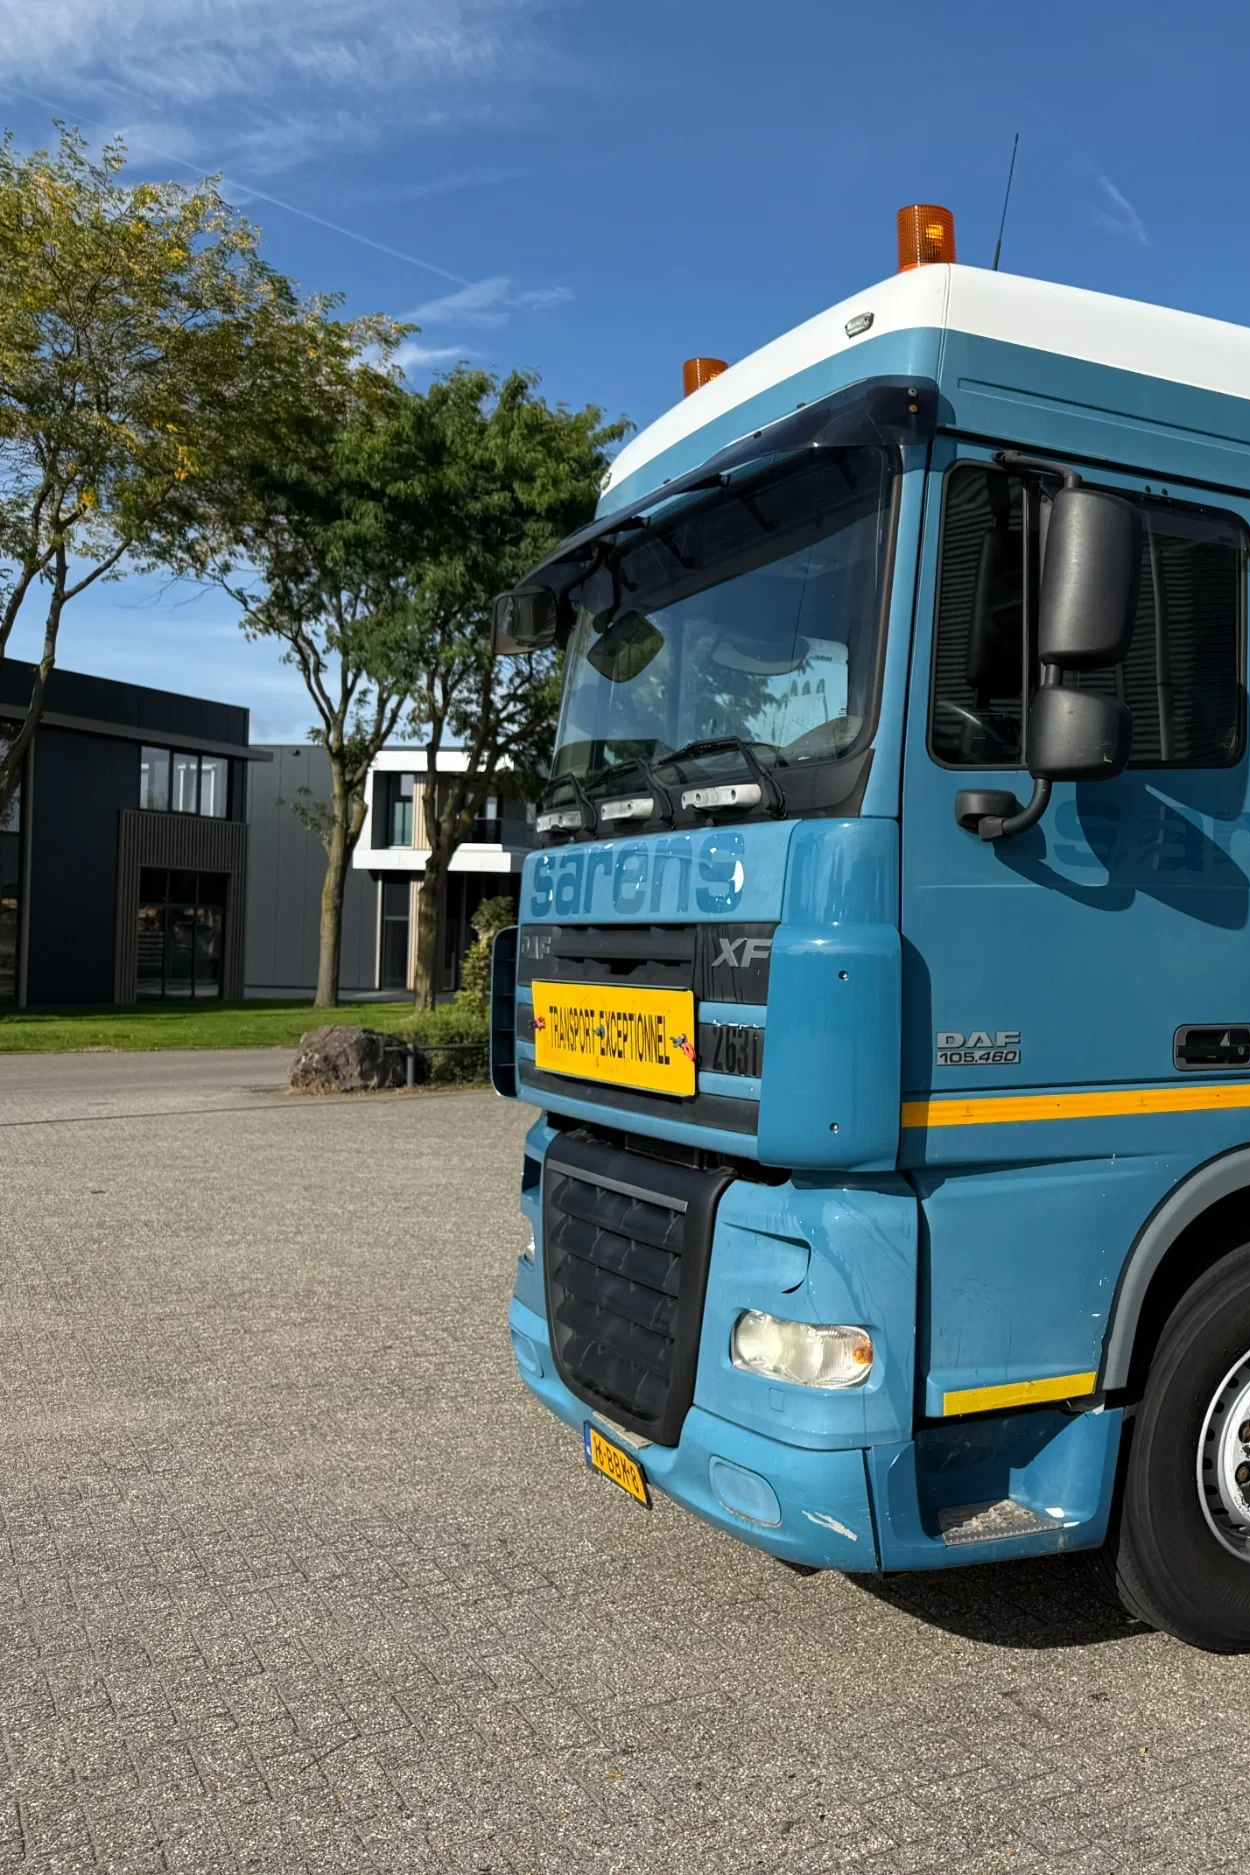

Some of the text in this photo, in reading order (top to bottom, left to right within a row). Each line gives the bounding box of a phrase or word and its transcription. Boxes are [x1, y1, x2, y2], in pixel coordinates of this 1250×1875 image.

[530, 831, 746, 918] sarens
[711, 937, 774, 968] XF
[548, 1004, 671, 1066] TRANSPORT EXCEPTIONNEL
[712, 1024, 761, 1078] 2631
[936, 1031, 1021, 1049] DAF
[939, 1050, 1018, 1065] 105.460
